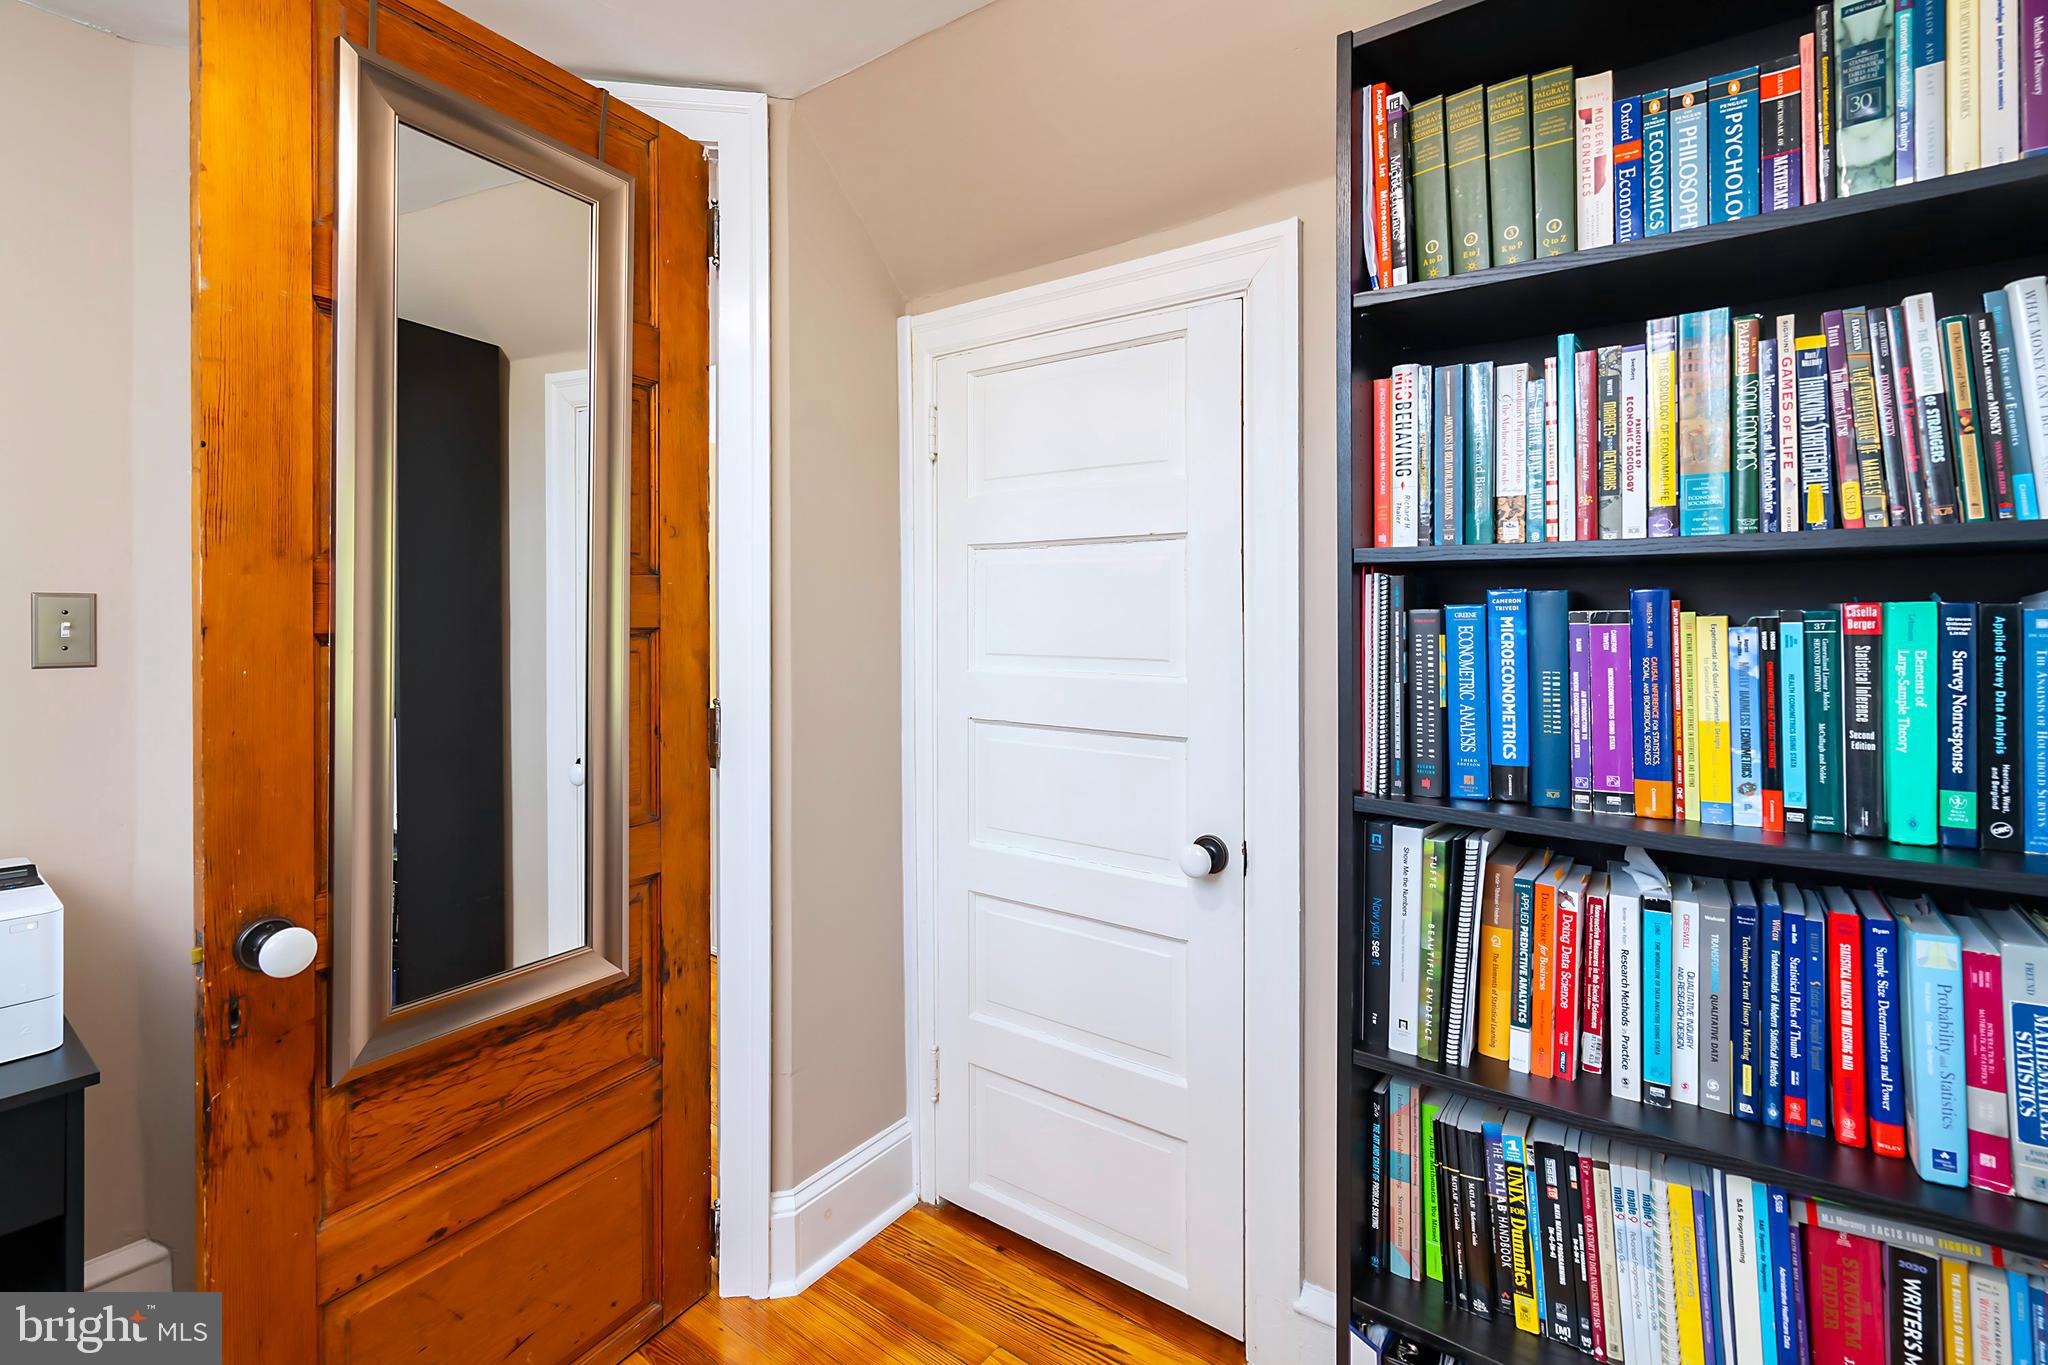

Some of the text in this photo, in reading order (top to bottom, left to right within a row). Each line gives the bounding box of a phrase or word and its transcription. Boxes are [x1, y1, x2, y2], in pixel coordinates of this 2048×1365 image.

[2032, 16, 2044, 96] Methods of Discovery
[1490, 95, 1524, 110] PALGRAVE
[1534, 85, 1570, 99] PALGRAVE
[1850, 92, 1872, 112] 30
[1898, 14, 1910, 151] Economic methodology: an inquiry
[1595, 108, 1605, 154] MODERN
[1620, 103, 1632, 141] Oxford
[1376, 89, 1384, 126] Acemoglu
[1380, 190, 1390, 261] Microeconomics
[1582, 128, 1592, 197] ECONOMICS
[1648, 131, 1664, 230] ECONOMICS
[1543, 239, 1550, 247] Q
[1560, 235, 1566, 243] Z
[1551, 222, 1557, 230] 4
[1737, 322, 1750, 374] PALGRAVE
[1851, 319, 1862, 350] FLIGSTEIN
[1395, 372, 1413, 477] MISBEHAVING
[1660, 357, 1670, 500] THE SOCIOLOGY OF ECONOMIC LIFE
[1737, 380, 1758, 470] SOCIAL ECONOMICS
[1782, 357, 1794, 469] GAMES OF LIFE
[1626, 396, 1634, 492] ECONOMIC SOCIOLOGY
[1635, 459, 1642, 468] OF
[1763, 375, 1776, 513] Micromotives and Macrobehavior
[1846, 486, 1857, 515] USED
[1404, 522, 1411, 530] H.
[1710, 623, 1718, 659] Experimental
[1848, 618, 1876, 630] Berger
[1642, 657, 1650, 681] SOCIAL,
[1650, 657, 1658, 682] CAUSAL
[1813, 639, 1821, 661] SECOND
[1458, 626, 1475, 752] ECONOMETRIC ANALYSIS
[1500, 617, 1516, 759] MICROECONOMETRICS
[1651, 683, 1659, 719] INFERENCE
[1712, 673, 1720, 725] Quasi-Experimental
[1855, 645, 1872, 722] Statistical Inference
[1896, 650, 1910, 753] Large-Sample Theory
[1915, 650, 1927, 707] Elements of
[1993, 617, 2007, 754] Applied Survey Data Analysis
[1849, 730, 1874, 740] Second
[1948, 651, 1967, 773] Survey Nonresponse
[1652, 732, 1660, 766] STATISTICS,
[1713, 728, 1721, 749] Designs
[1851, 741, 1876, 750] Edition
[1403, 865, 1409, 876] Me
[1429, 856, 1437, 888] TUFTE
[1372, 897, 1383, 919] Now
[1401, 888, 1409, 916] Numbers
[1520, 893, 1530, 924] APPLIED
[1370, 920, 1380, 939] you
[1372, 940, 1380, 957] see
[1519, 926, 1529, 976] PREDICTIVE
[1682, 914, 1690, 949] CRESWELL
[1772, 920, 1781, 941] Wilcox
[1425, 923, 1435, 1041] BEAUTIFUL EVIDENCE
[1560, 914, 1573, 1008] Doing Data Science
[2025, 963, 2035, 996] FREUND
[1518, 977, 1528, 1023] ANALYTICS
[1789, 957, 1801, 1058] Statistical Rules of Thumb
[1839, 944, 1853, 1070] STATISTICAL ANALYSIS WITH MISSING DATA
[1710, 994, 1719, 1062] QUALITATIVE DATA
[1875, 946, 1891, 1111] Sample Size Determination and Power
[2015, 1031, 2038, 1117] STATISTICS
[1493, 1143, 1511, 1267] THE MATLAB HANDBOOK
[1507, 1166, 1527, 1206] UNIX
[1614, 1187, 1623, 1212] maple
[1511, 1217, 1529, 1287] Dummies
[1736, 1215, 1746, 1264] Programming
[1899, 1260, 1928, 1274] 2020
[1822, 1264, 1839, 1329] FINDER
[1842, 1257, 1862, 1350] SYNONYM
[1903, 1278, 1923, 1351] WRITER'S
